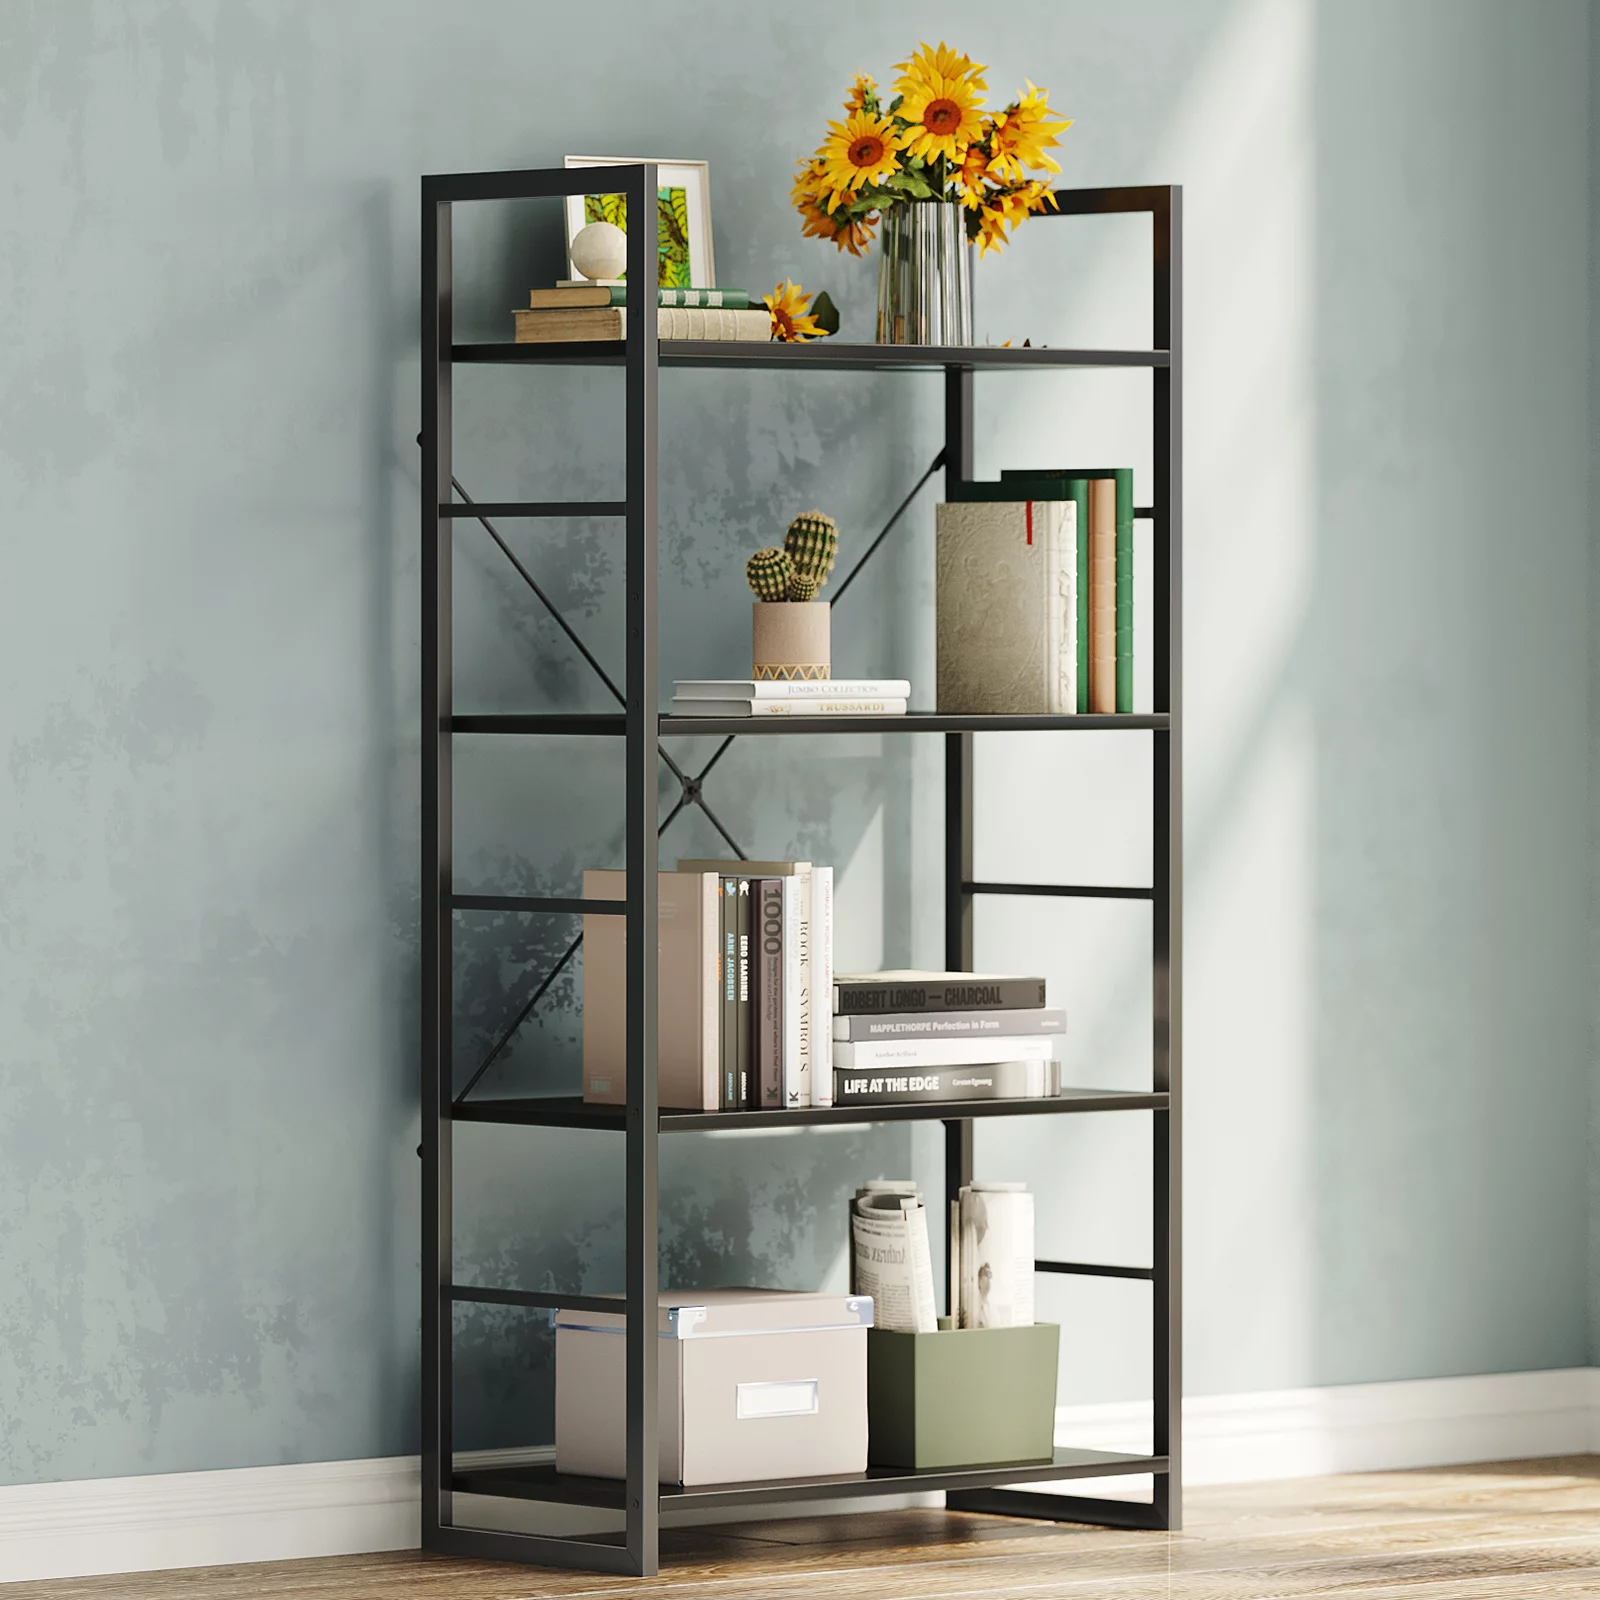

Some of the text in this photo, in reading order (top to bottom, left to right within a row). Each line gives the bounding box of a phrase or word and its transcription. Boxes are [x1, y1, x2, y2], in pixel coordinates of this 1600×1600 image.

[819, 703, 884, 711] TRUSSARDI
[764, 888, 782, 955] 1000
[727, 932, 735, 1001] ARNE JACOBSEN
[740, 935, 748, 1002] EERO SAARINEN
[843, 990, 887, 1009] ROBERT
[889, 988, 926, 1008] LONGO
[944, 986, 1003, 1006] CHARCOAL
[869, 1022, 931, 1033] MAPPLETHORPE
[932, 1021, 970, 1031] Perfection
[980, 1020, 1000, 1029] Form
[844, 1076, 939, 1094] LIFE AT THE EDGE
